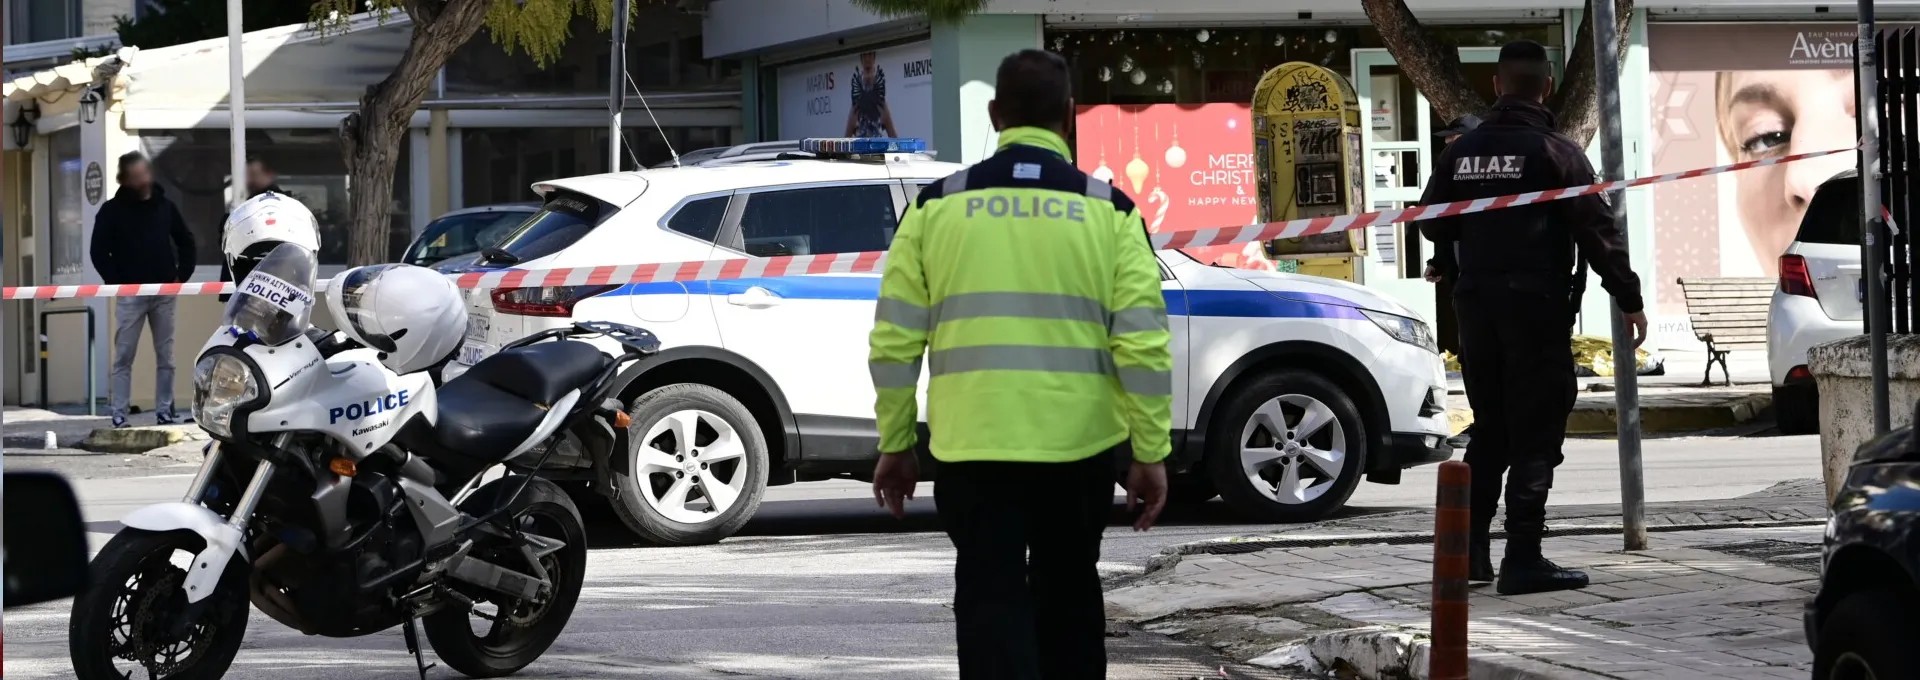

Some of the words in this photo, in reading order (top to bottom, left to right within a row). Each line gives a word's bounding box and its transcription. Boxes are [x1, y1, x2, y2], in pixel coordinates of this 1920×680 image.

[1208, 153, 1255, 169] MERR
[1457, 155, 1520, 173] ΔΙ.ΑΣ.
[1190, 169, 1256, 186] CHRIST
[965, 195, 1085, 222] POLICE
[1188, 197, 1226, 206] HAPPY
[246, 282, 289, 308] POLICE
[288, 357, 319, 380] Versys
[329, 389, 409, 425] POLICE
[352, 418, 390, 437] Kawasaki
